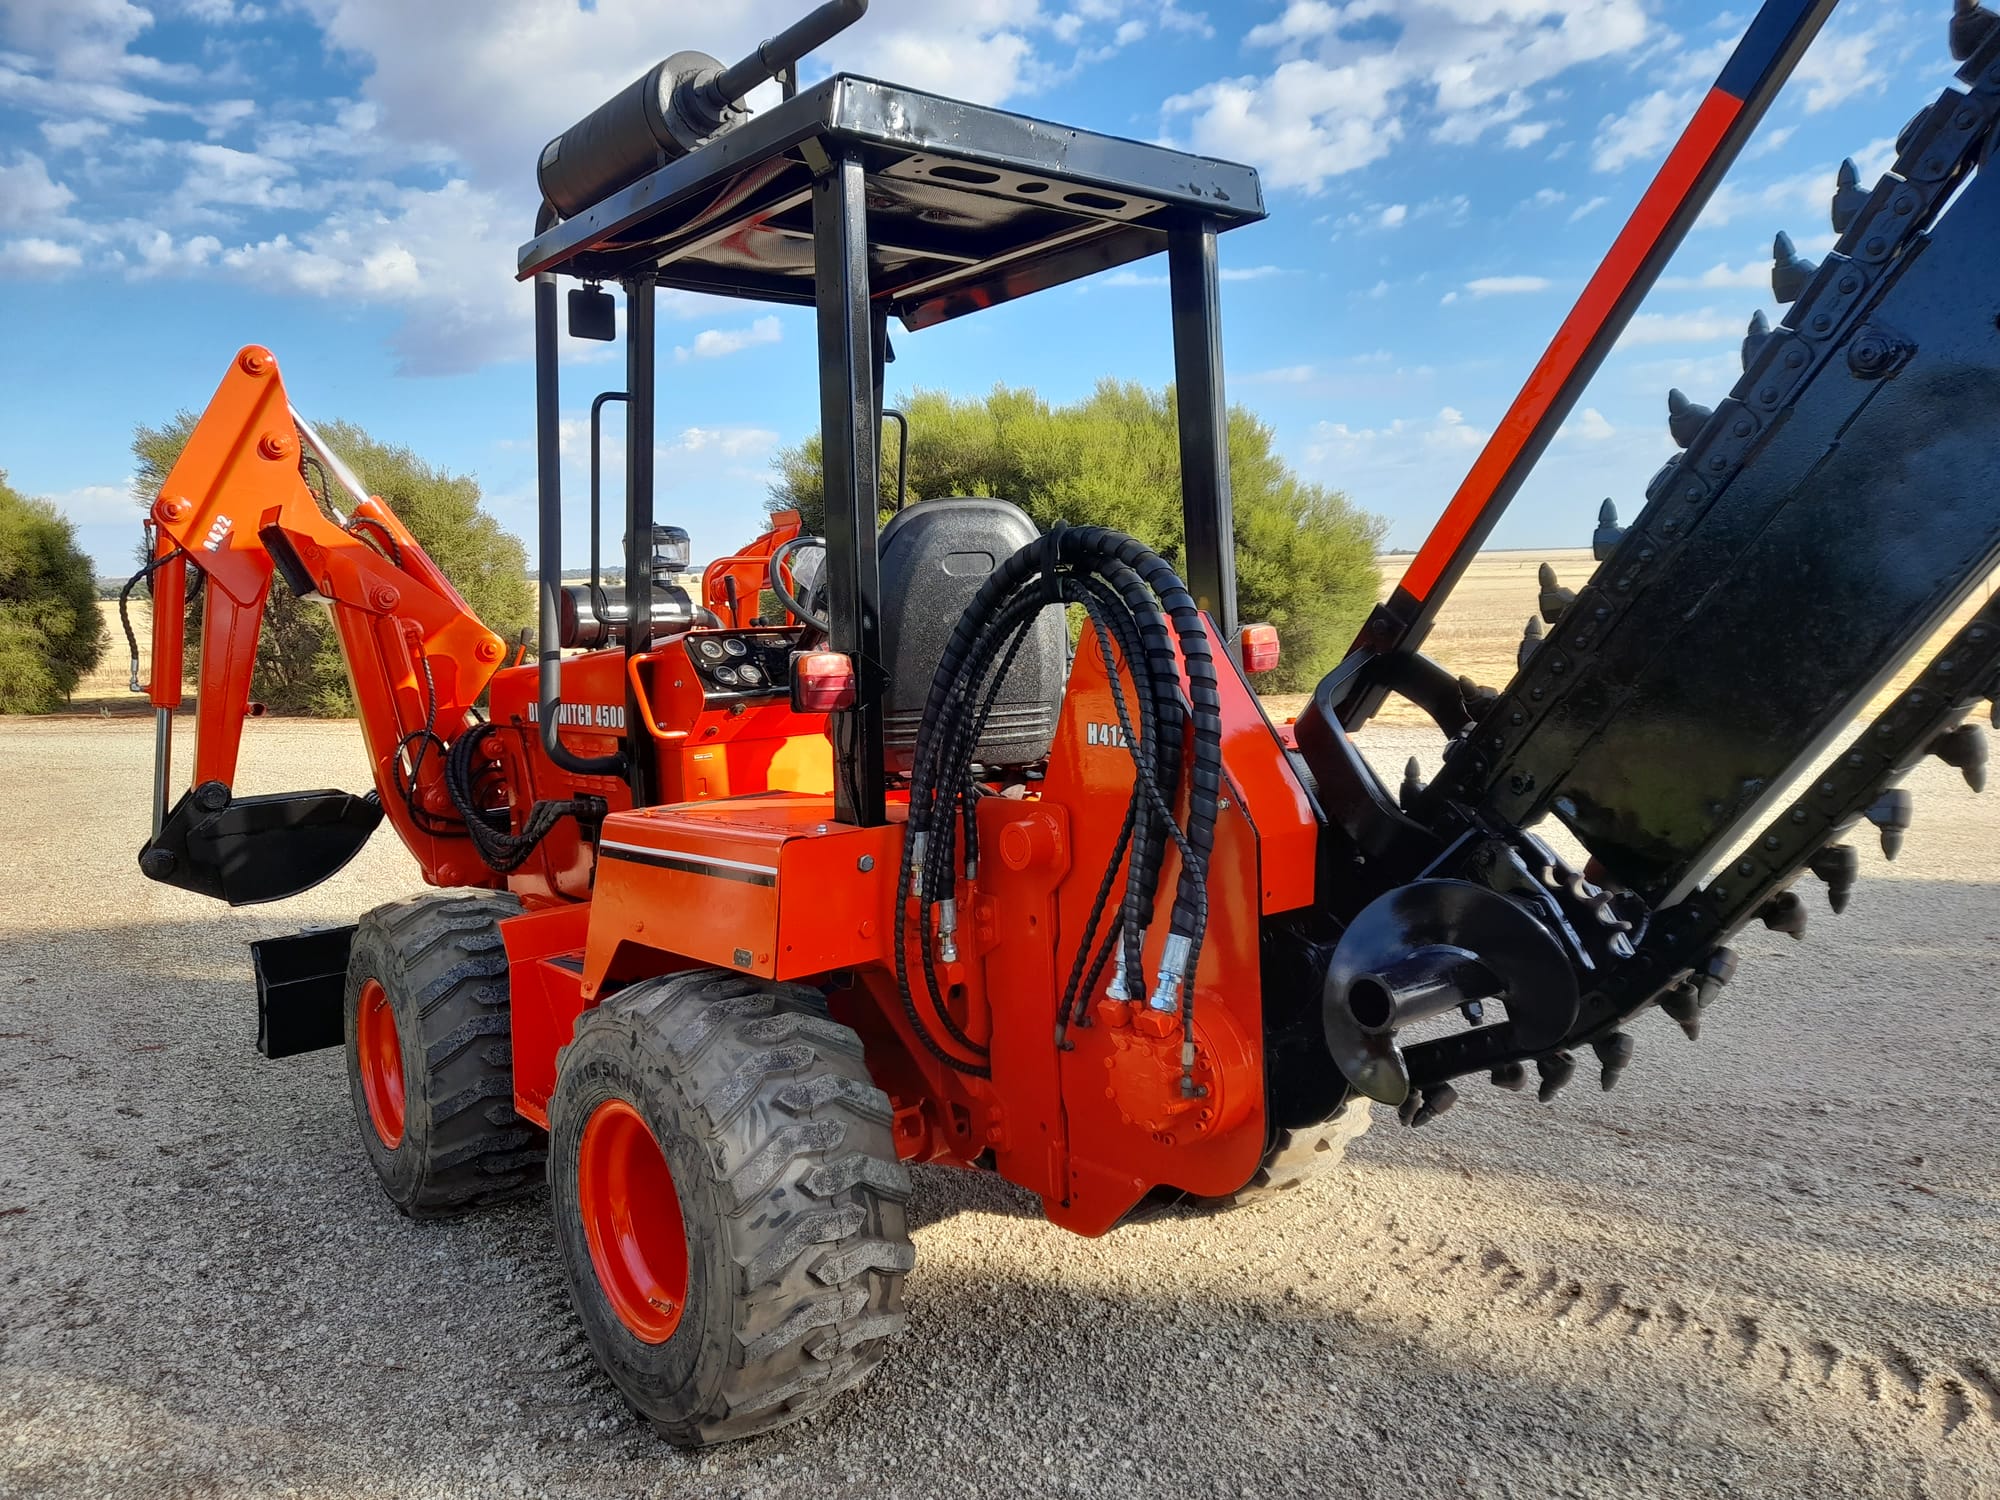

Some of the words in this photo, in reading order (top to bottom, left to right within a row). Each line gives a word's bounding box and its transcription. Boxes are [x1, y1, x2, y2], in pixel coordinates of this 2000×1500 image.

[203, 515, 232, 552] A422
[595, 705, 625, 728] 4500
[1087, 723, 1129, 748] H412
